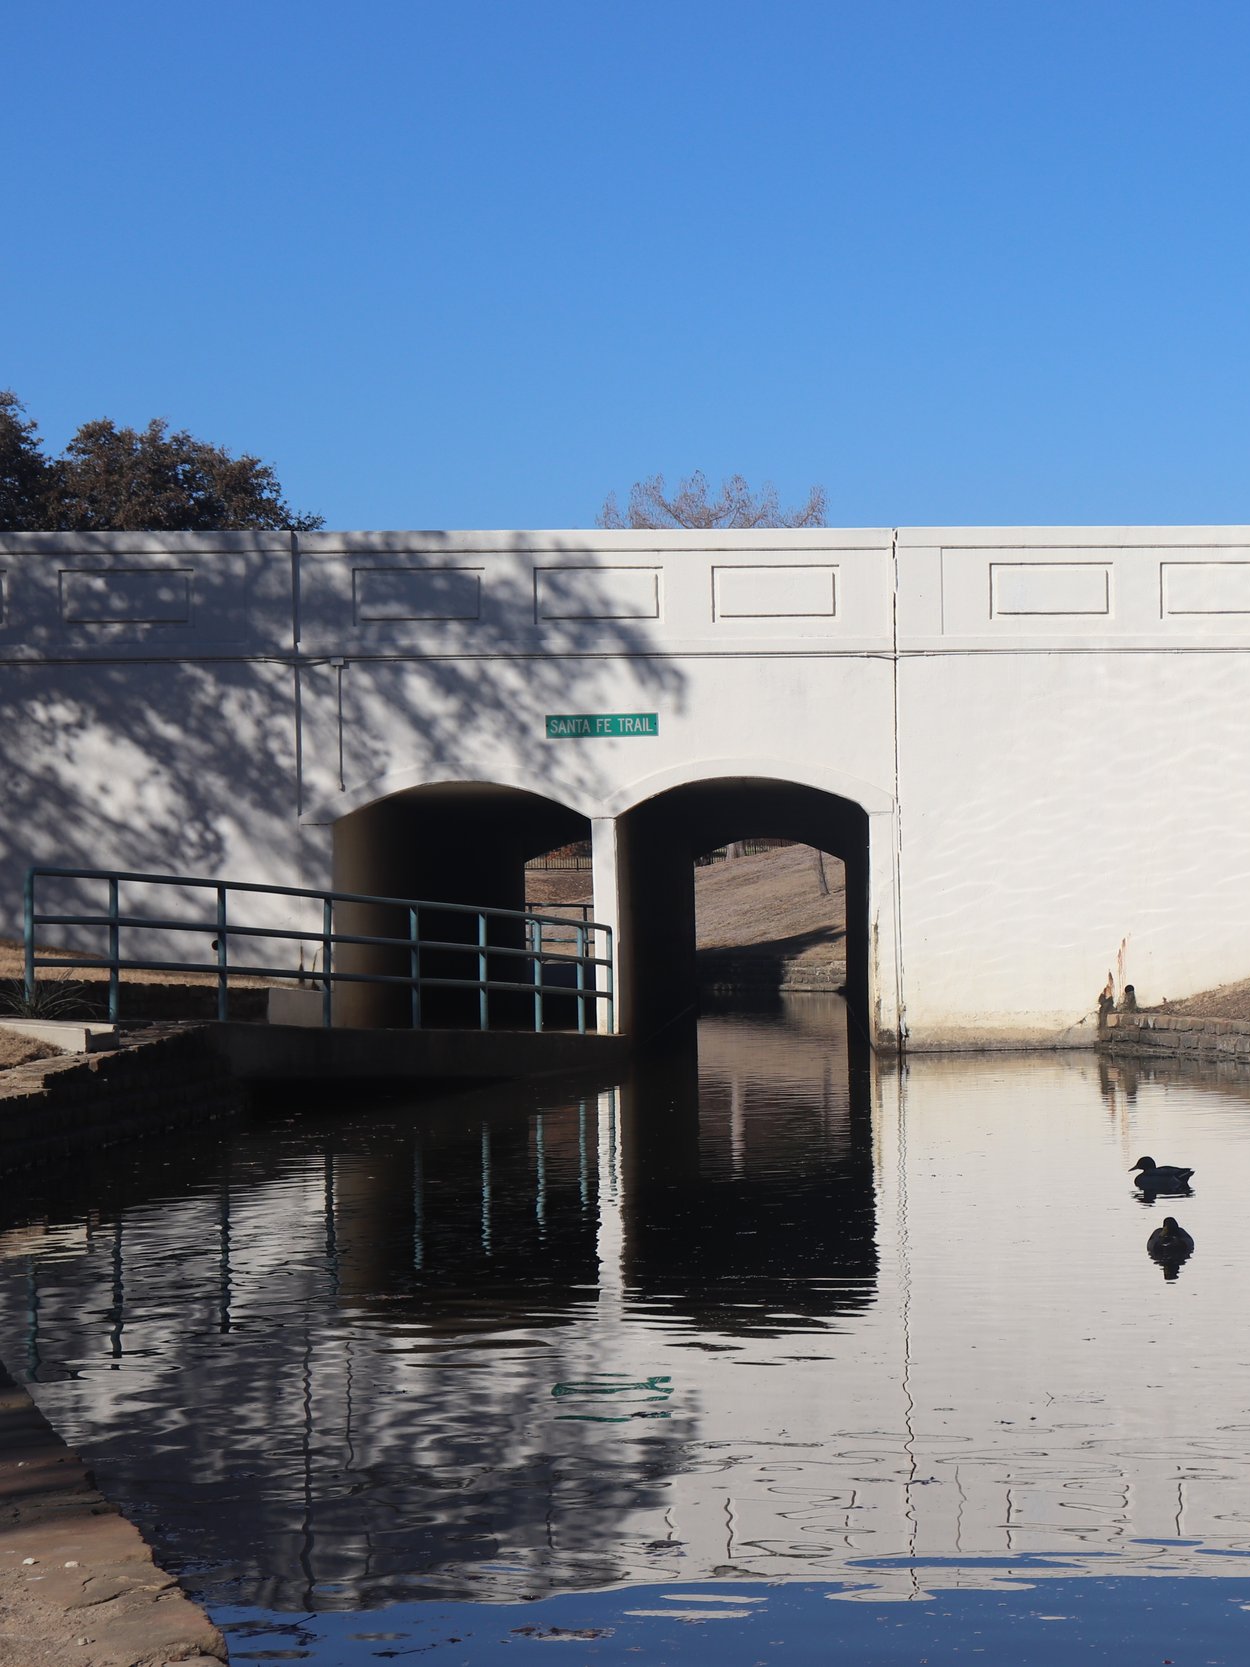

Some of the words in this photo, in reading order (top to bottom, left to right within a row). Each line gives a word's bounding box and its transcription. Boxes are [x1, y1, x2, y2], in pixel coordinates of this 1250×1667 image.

[550, 719, 591, 734] SANTA
[596, 719, 612, 733] FE
[618, 717, 654, 732] TRAIL
